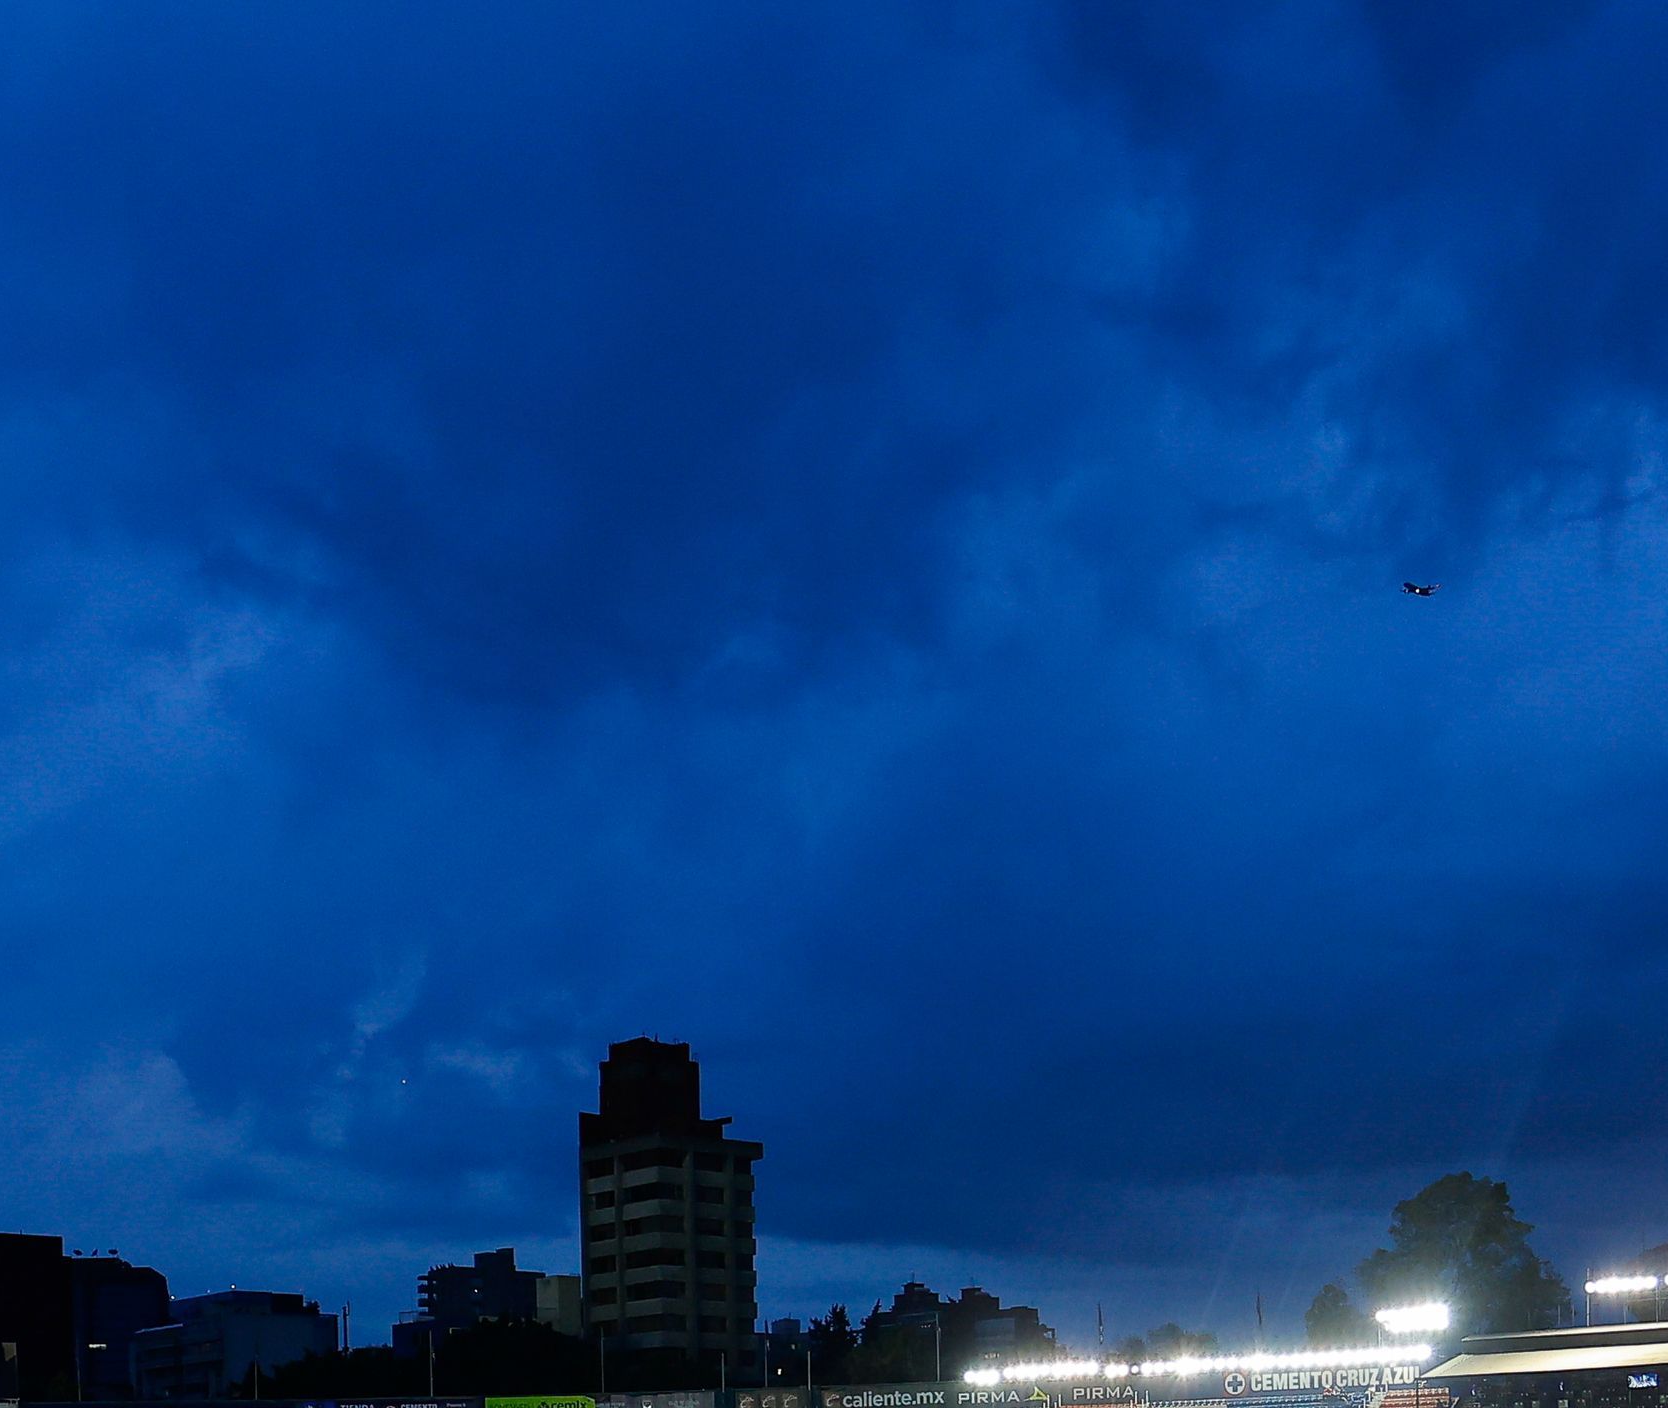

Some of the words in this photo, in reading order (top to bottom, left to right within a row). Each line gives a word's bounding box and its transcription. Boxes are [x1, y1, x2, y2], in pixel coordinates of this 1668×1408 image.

[1251, 1371, 1332, 1392] CEMENTO
[1335, 1368, 1379, 1388] CRUZ
[1379, 1366, 1421, 1385] AZUL
[842, 1390, 945, 1408] caliente.mx
[958, 1390, 1020, 1405] PIRMA
[1073, 1385, 1134, 1400] PIRMA
